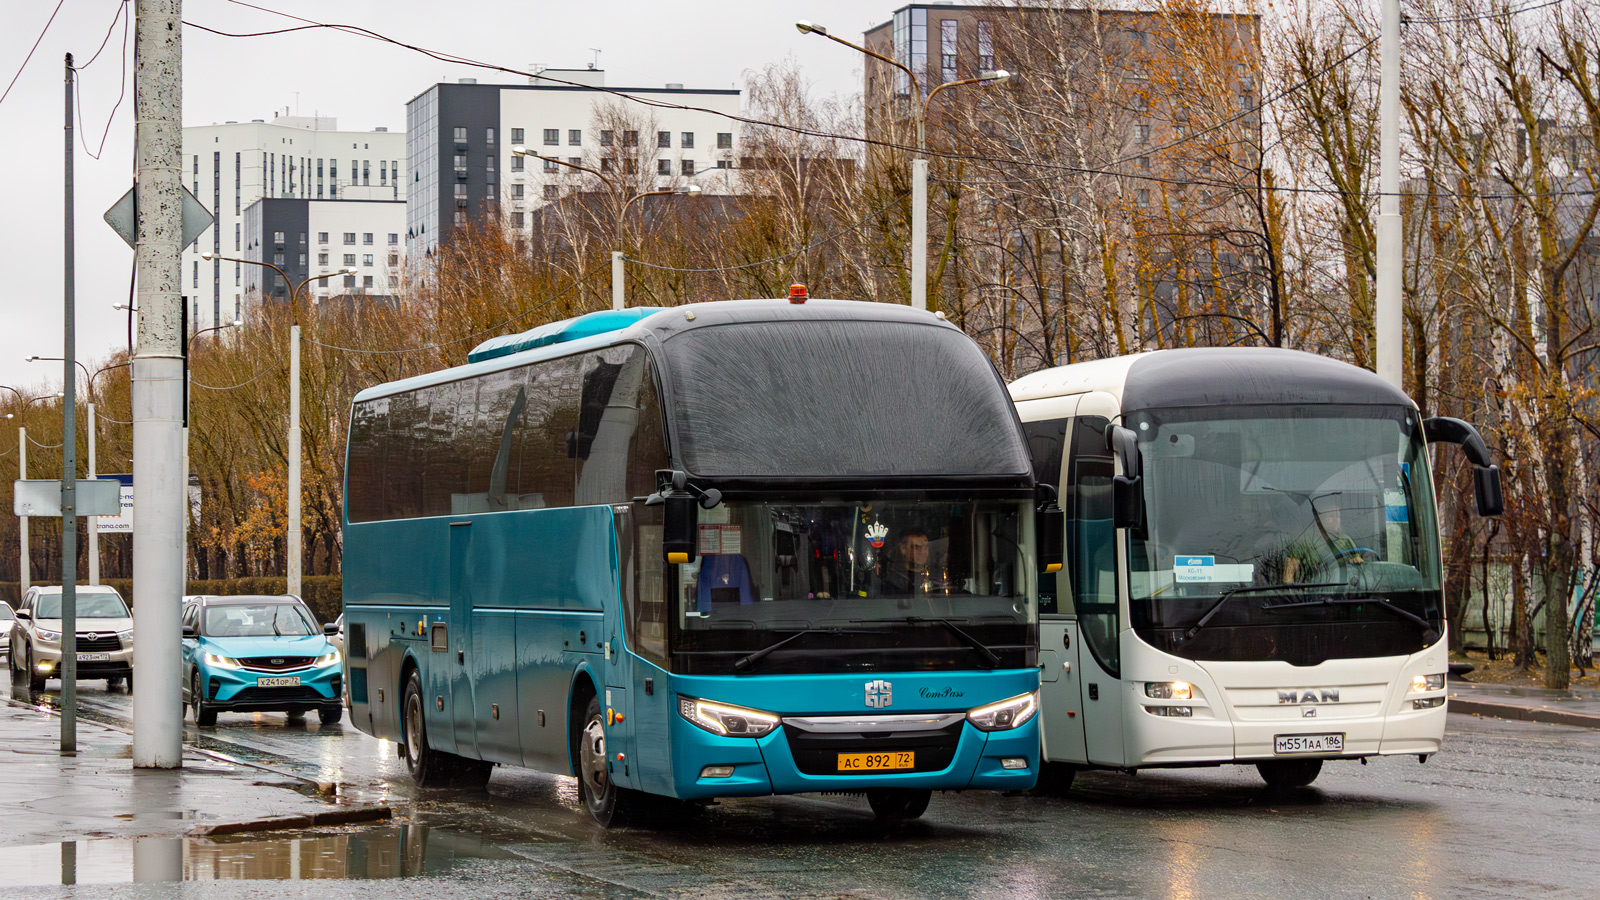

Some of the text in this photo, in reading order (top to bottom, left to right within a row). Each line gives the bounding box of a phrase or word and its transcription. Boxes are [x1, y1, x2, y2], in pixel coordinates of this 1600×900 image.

[918, 686, 964, 699] ComPass
[1277, 689, 1340, 704] MAN
[1323, 736, 1341, 746] 186
[865, 755, 890, 768] 892
[897, 753, 910, 763] 72
